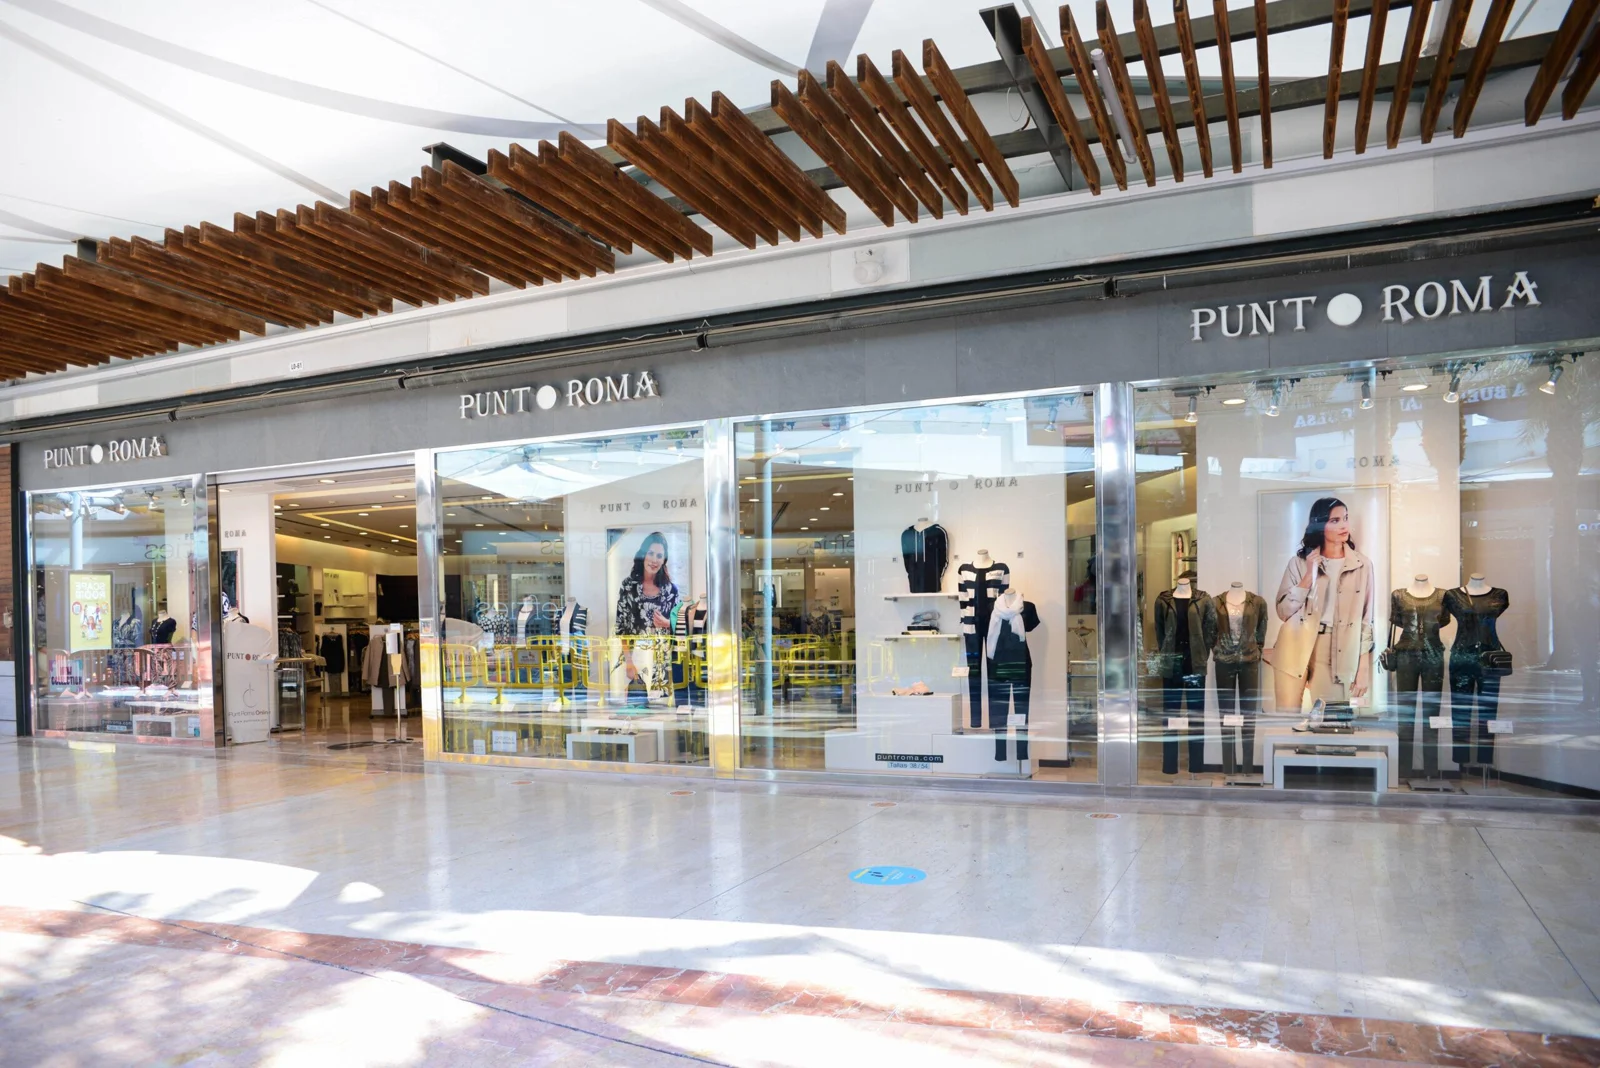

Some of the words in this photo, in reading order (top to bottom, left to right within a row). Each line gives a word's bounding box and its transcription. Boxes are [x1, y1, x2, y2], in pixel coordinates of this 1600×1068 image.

[1190, 296, 1317, 341] PUNT
[1380, 271, 1542, 324] ROMA
[459, 386, 531, 419] PUNT
[565, 371, 657, 408] ROMA
[44, 445, 88, 469] PUNT
[108, 436, 161, 462] ROMA
[893, 482, 933, 494] PUNT
[974, 477, 1018, 489] ROMA
[600, 502, 631, 513] PUNT
[663, 498, 698, 509] ROMA
[876, 753, 942, 762] puntroma.com
